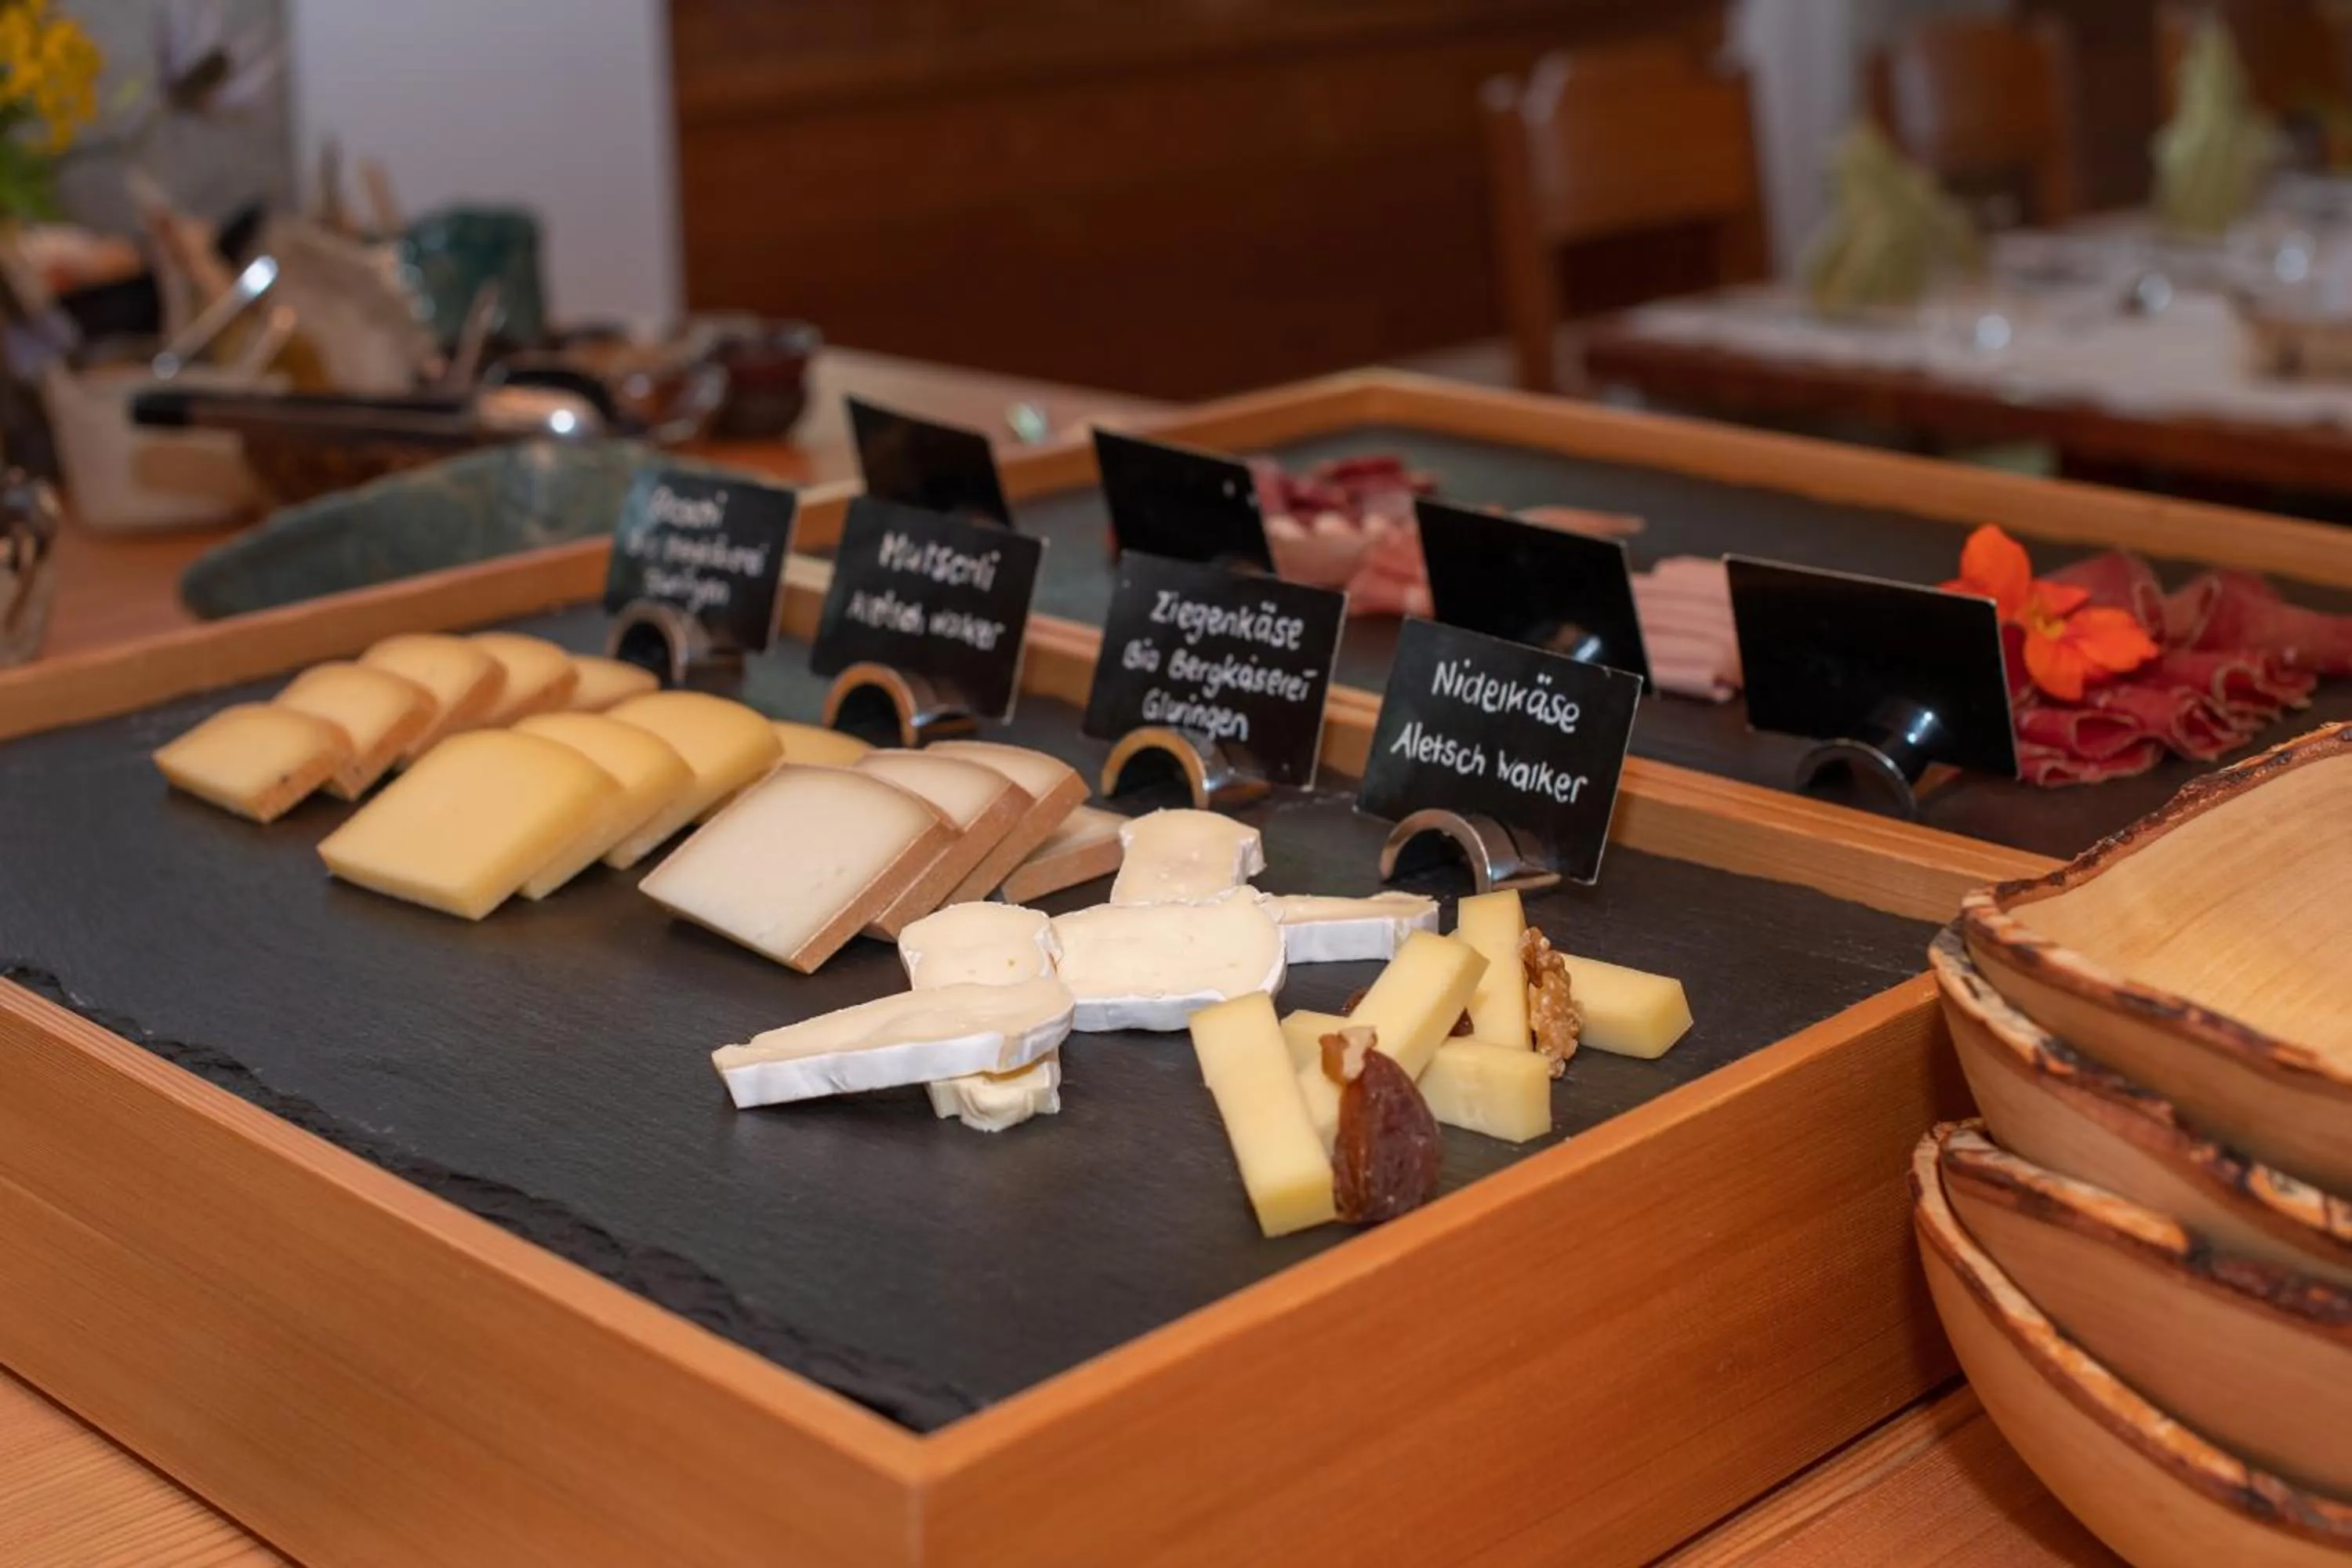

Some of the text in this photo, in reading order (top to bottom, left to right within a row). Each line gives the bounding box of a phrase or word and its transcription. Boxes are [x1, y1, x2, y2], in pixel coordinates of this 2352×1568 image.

[1149, 590, 1305, 651] Ziegenkäse
[1430, 659, 1581, 734] Nidelkäse
[1390, 721, 1488, 777] Aletsch
